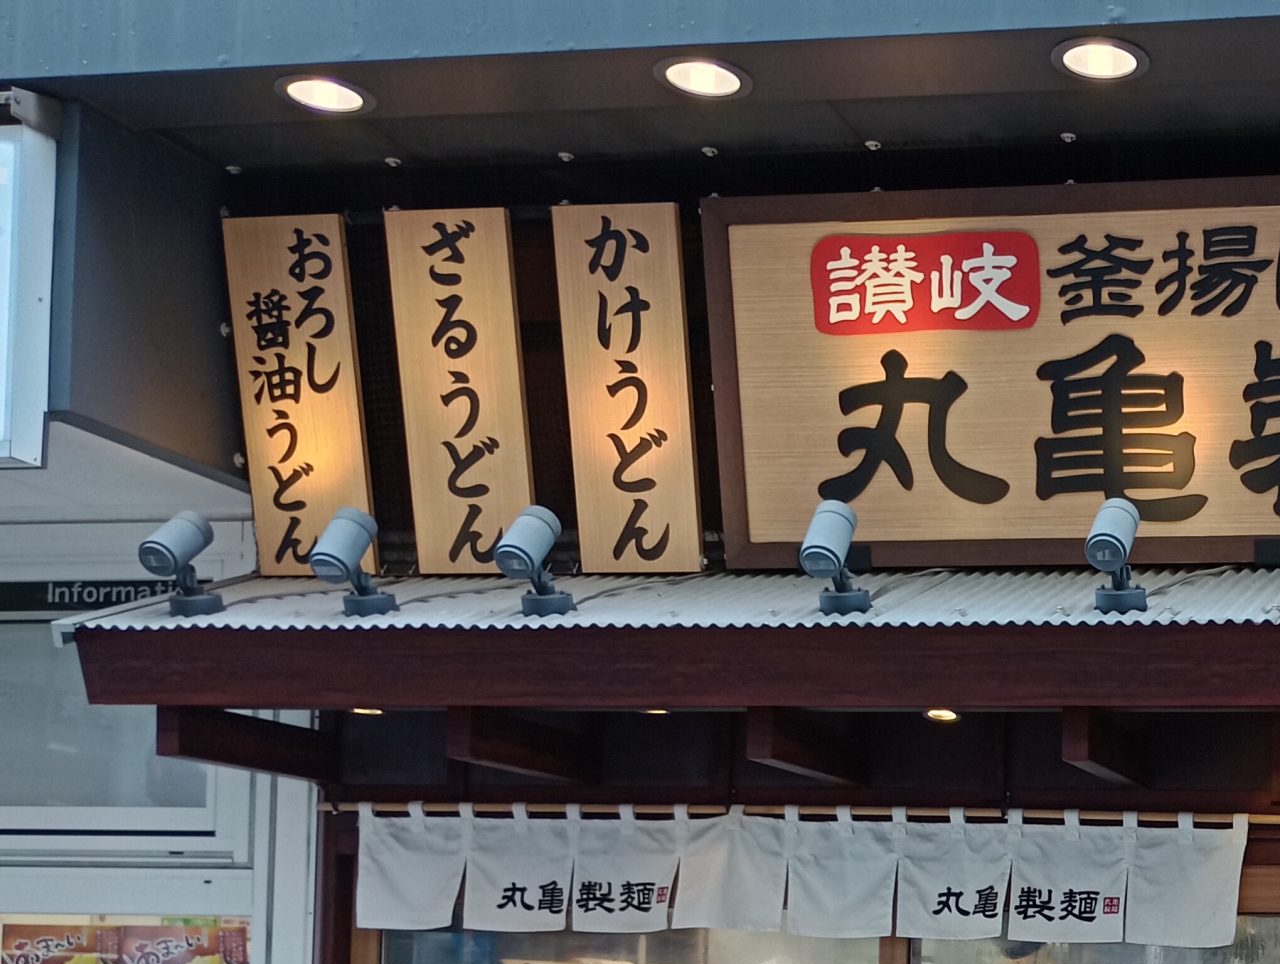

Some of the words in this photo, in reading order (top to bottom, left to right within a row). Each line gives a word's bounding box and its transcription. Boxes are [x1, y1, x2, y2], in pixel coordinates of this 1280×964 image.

[826, 242, 1030, 325] 讃岐
[421, 220, 503, 564] ざるうどん
[585, 216, 670, 562] かけうどん
[497, 880, 656, 914] 丸亀製麺
[932, 885, 1101, 922] 丸亀製麺
